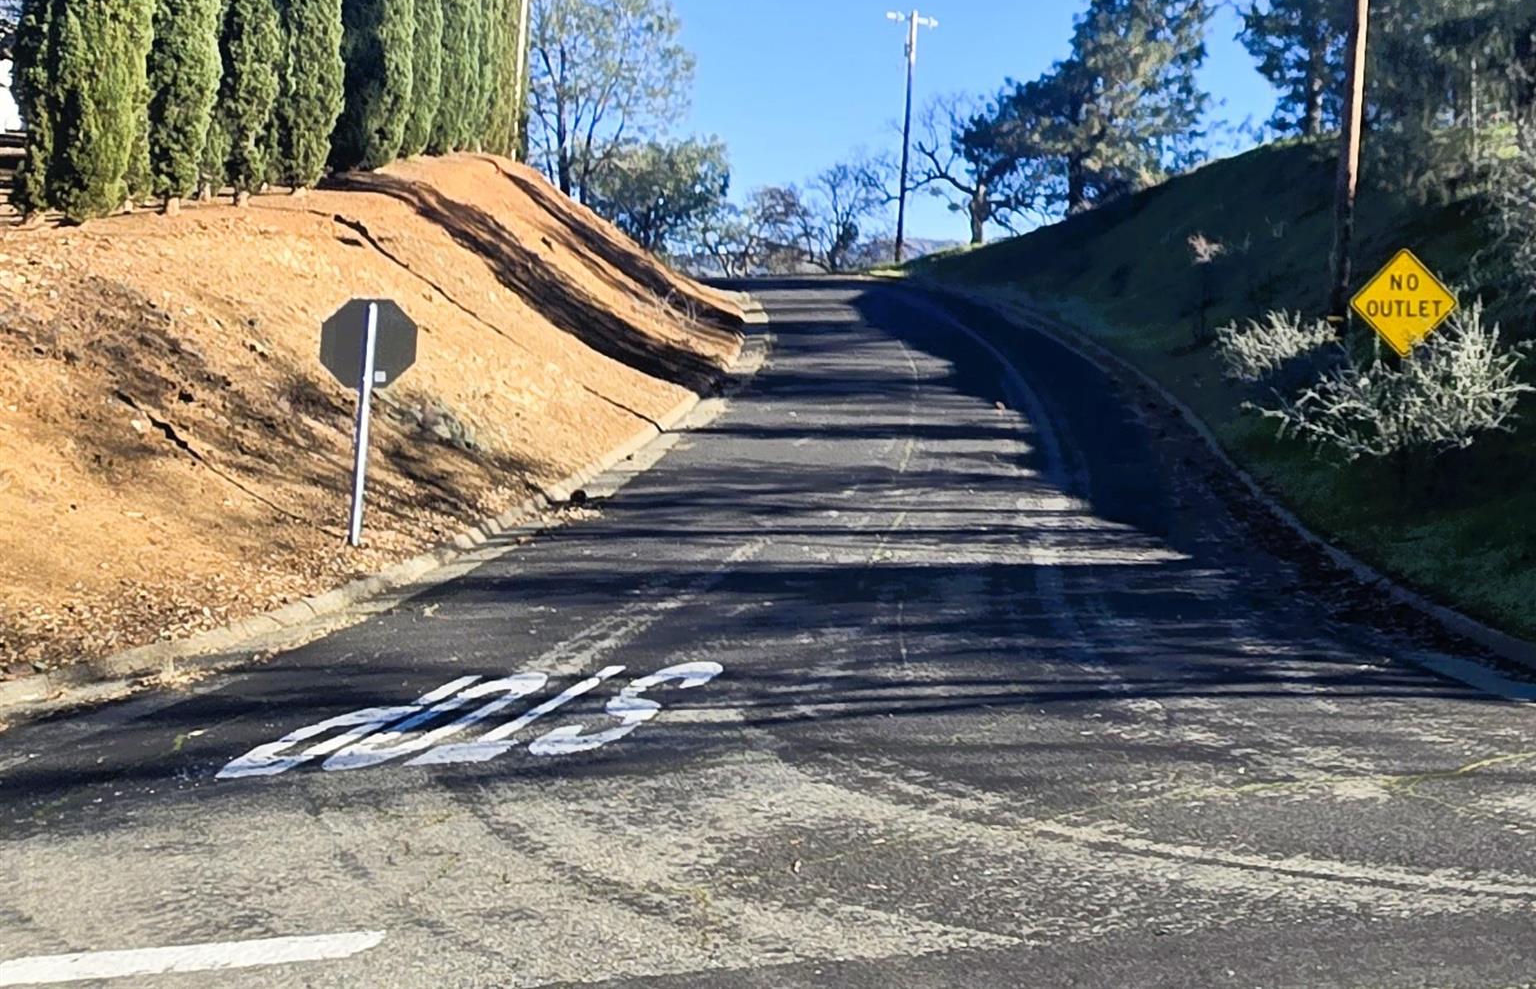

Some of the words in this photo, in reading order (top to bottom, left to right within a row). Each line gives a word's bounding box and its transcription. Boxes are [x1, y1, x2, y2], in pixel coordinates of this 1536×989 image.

[1390, 274, 1419, 291] NO
[1366, 300, 1442, 317] OUTLET
[215, 661, 723, 779] STOP
